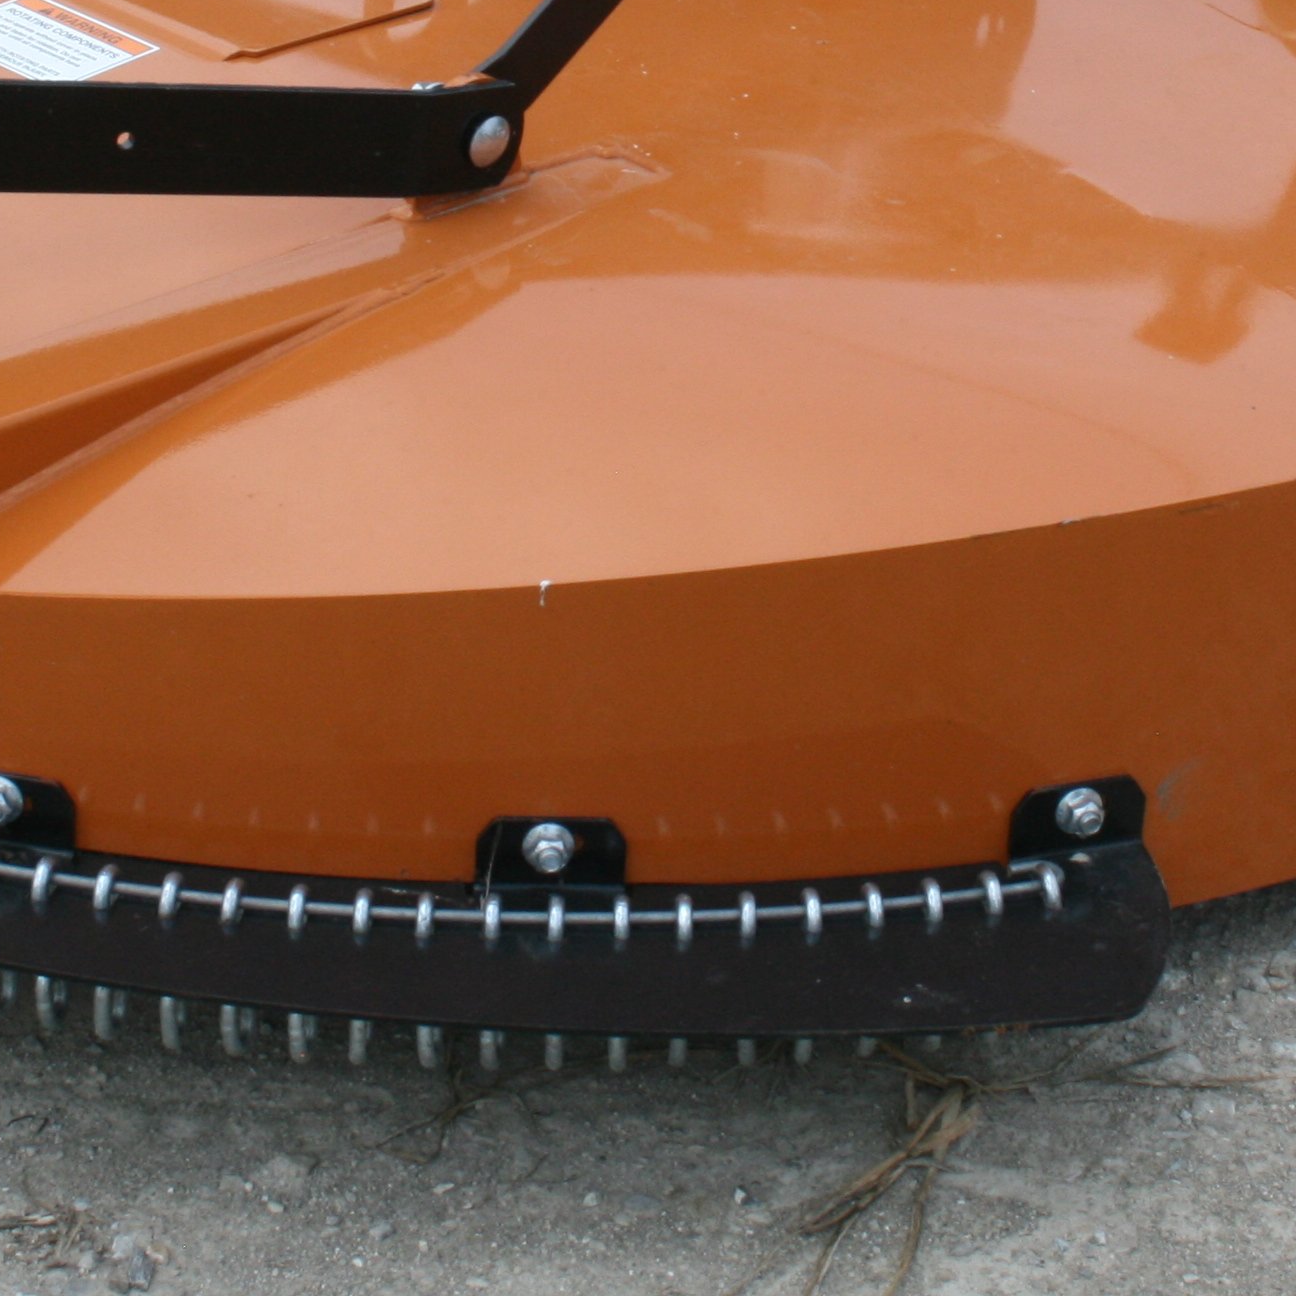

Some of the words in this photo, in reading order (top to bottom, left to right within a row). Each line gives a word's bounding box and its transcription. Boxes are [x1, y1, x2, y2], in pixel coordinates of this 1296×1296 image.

[6, 7, 54, 30] ROTATING
[52, 27, 120, 59] COMPONENTS
[55, 12, 122, 44] WARNING
